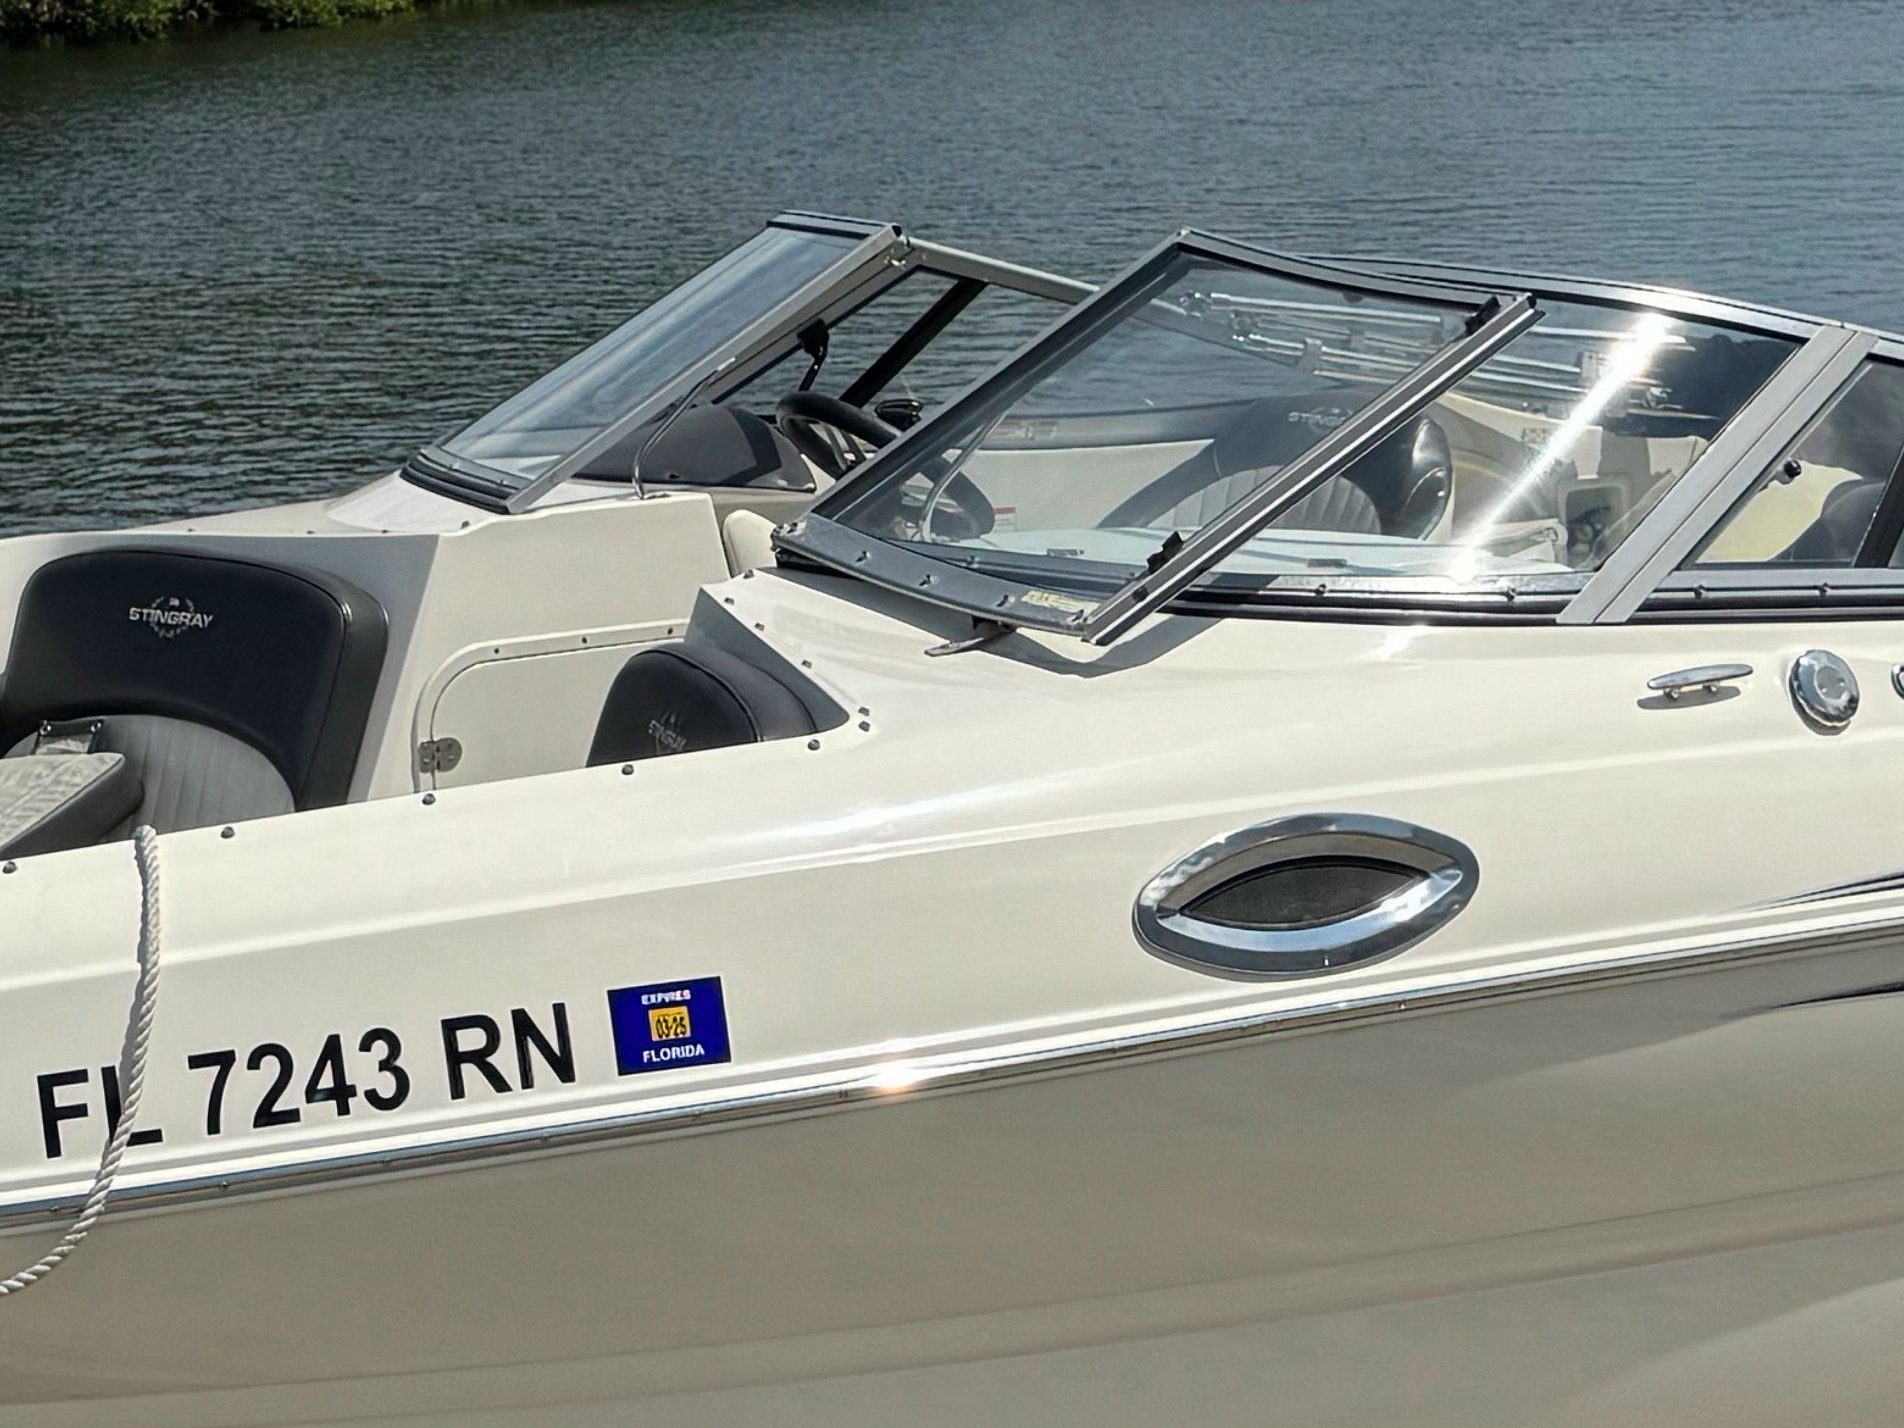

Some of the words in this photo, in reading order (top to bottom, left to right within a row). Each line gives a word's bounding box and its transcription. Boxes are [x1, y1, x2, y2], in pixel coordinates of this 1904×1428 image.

[129, 606, 214, 629] STINGRAY
[642, 1043, 706, 1064] FLORIDA
[37, 1065, 164, 1159] FL
[187, 1027, 411, 1136] 7243
[440, 1002, 577, 1101] RN
